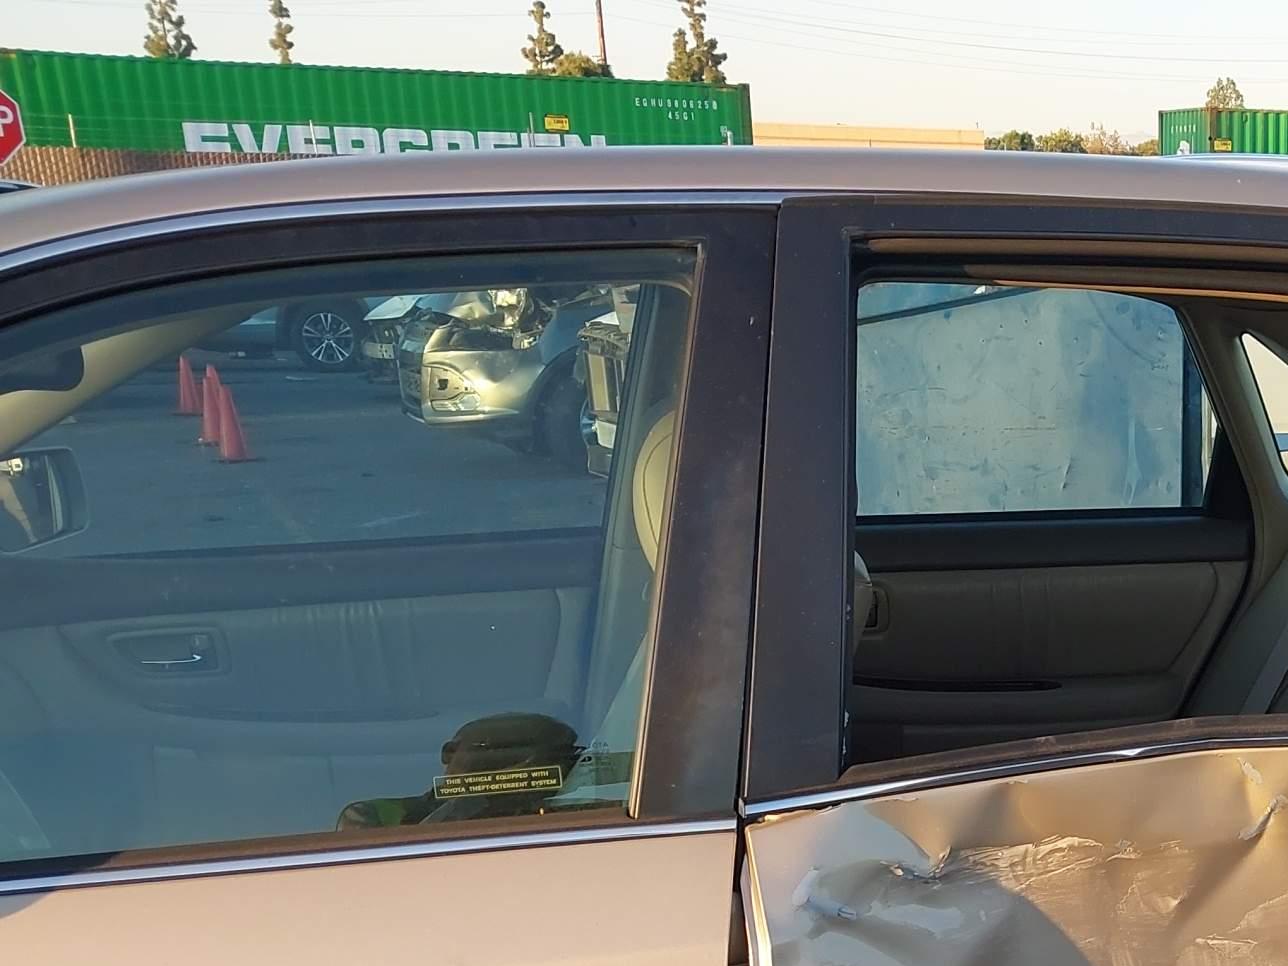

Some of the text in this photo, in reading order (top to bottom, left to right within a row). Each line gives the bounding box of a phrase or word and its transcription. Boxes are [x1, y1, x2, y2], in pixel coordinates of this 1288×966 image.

[464, 775, 492, 784] VEHICLE
[496, 772, 528, 781] EQUIPPED
[440, 787, 466, 795] TOYOTA
[531, 778, 557, 787] SYSTEM
